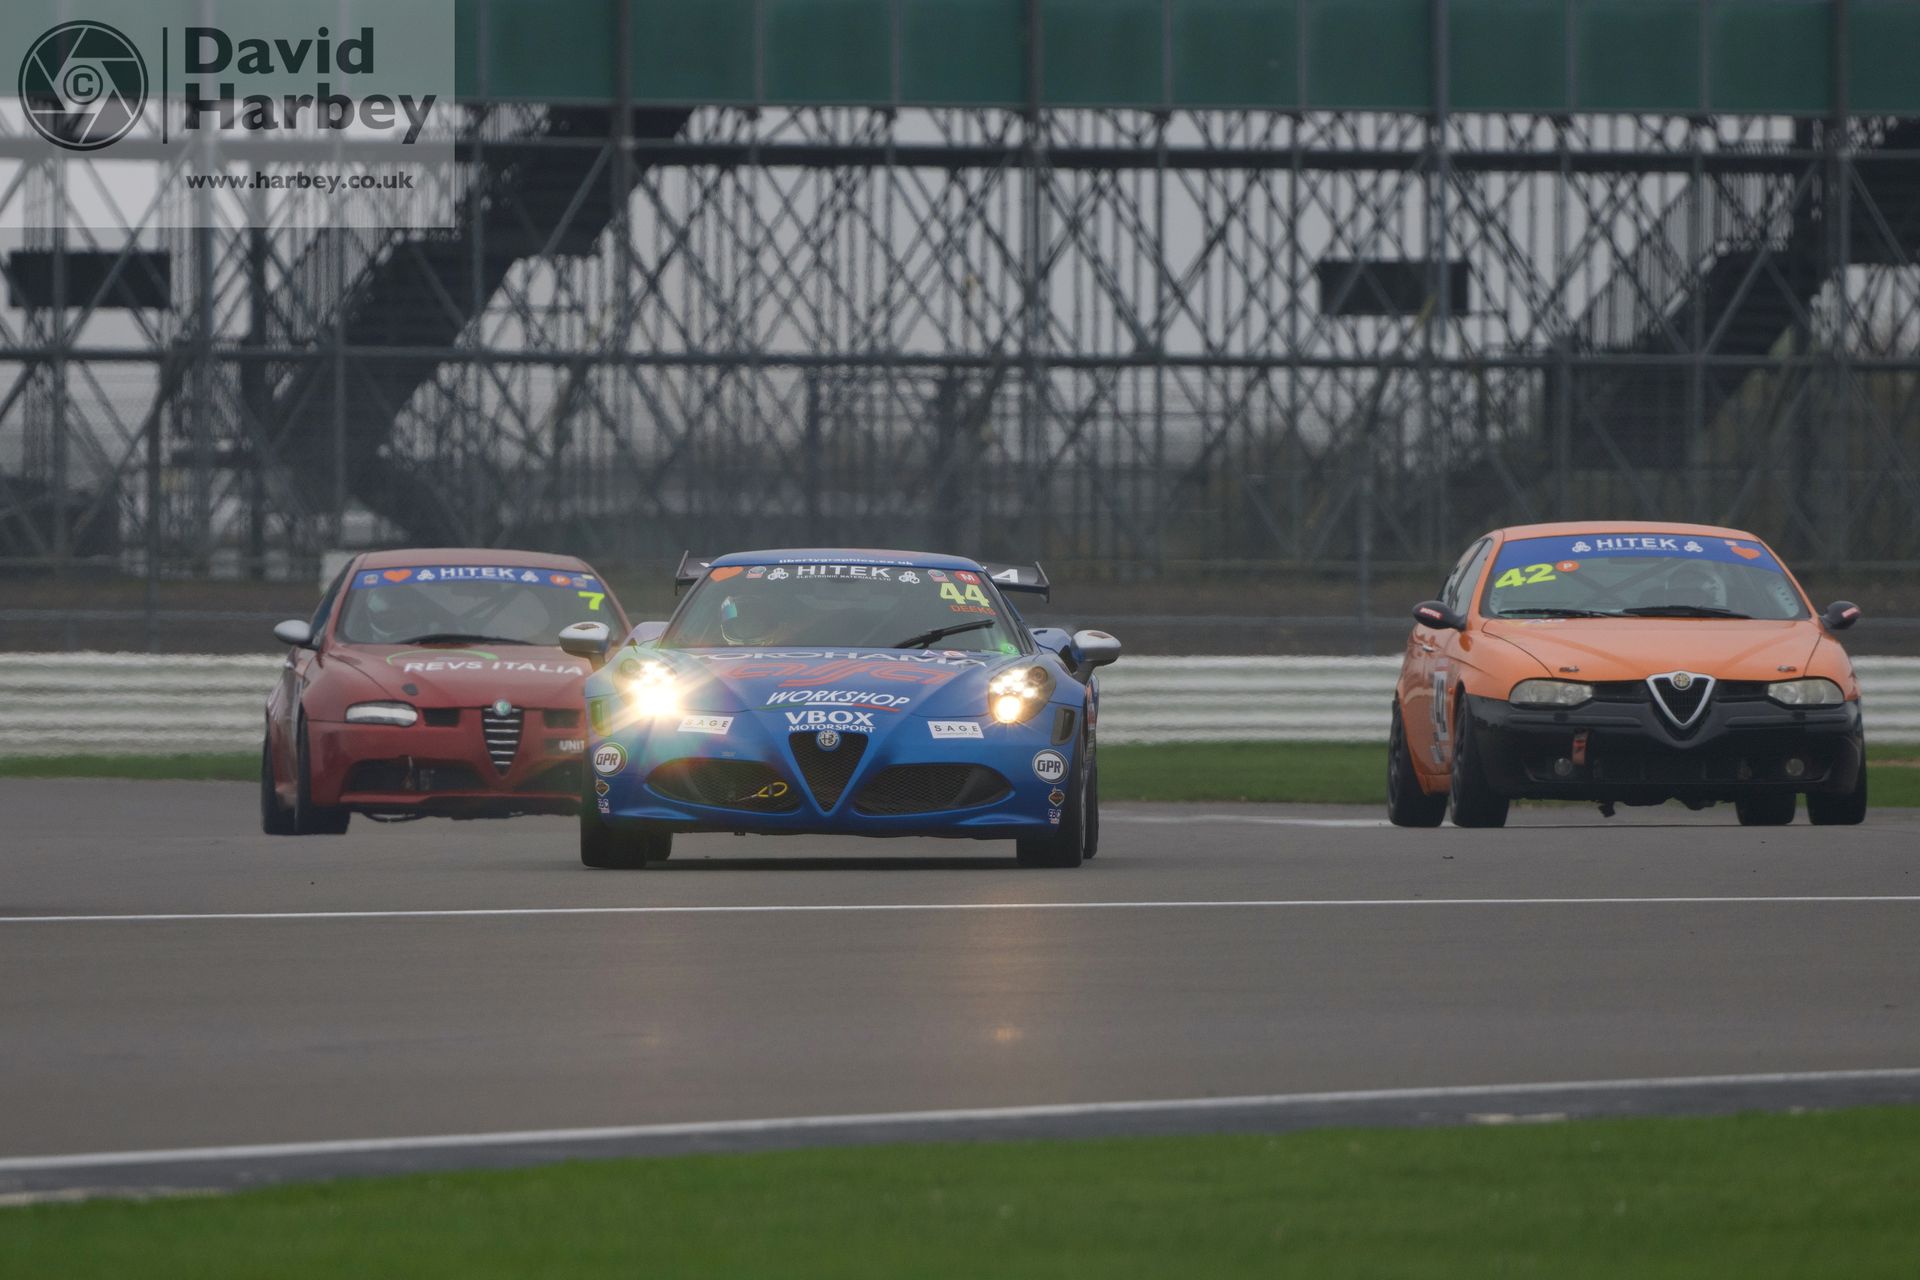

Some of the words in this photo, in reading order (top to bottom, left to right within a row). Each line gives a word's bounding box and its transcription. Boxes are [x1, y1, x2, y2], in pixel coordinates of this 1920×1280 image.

[1596, 537, 1678, 549] HITEK
[440, 567, 515, 578] HITEK
[797, 564, 891, 578] HITEK
[1495, 563, 1557, 588] 42
[577, 591, 605, 611] 7
[940, 582, 991, 608] 44
[949, 604, 998, 617] DEEKS
[687, 650, 987, 668] YOKOHAMA
[403, 661, 483, 673] REVS
[492, 661, 584, 676] ITALIA
[766, 690, 911, 707] WORKSHOP
[685, 719, 729, 728] SAGE
[785, 710, 876, 727] VBOX
[788, 723, 877, 734] MOTORSPORT
[595, 753, 619, 766] GPR
[1037, 760, 1062, 774] GPR
